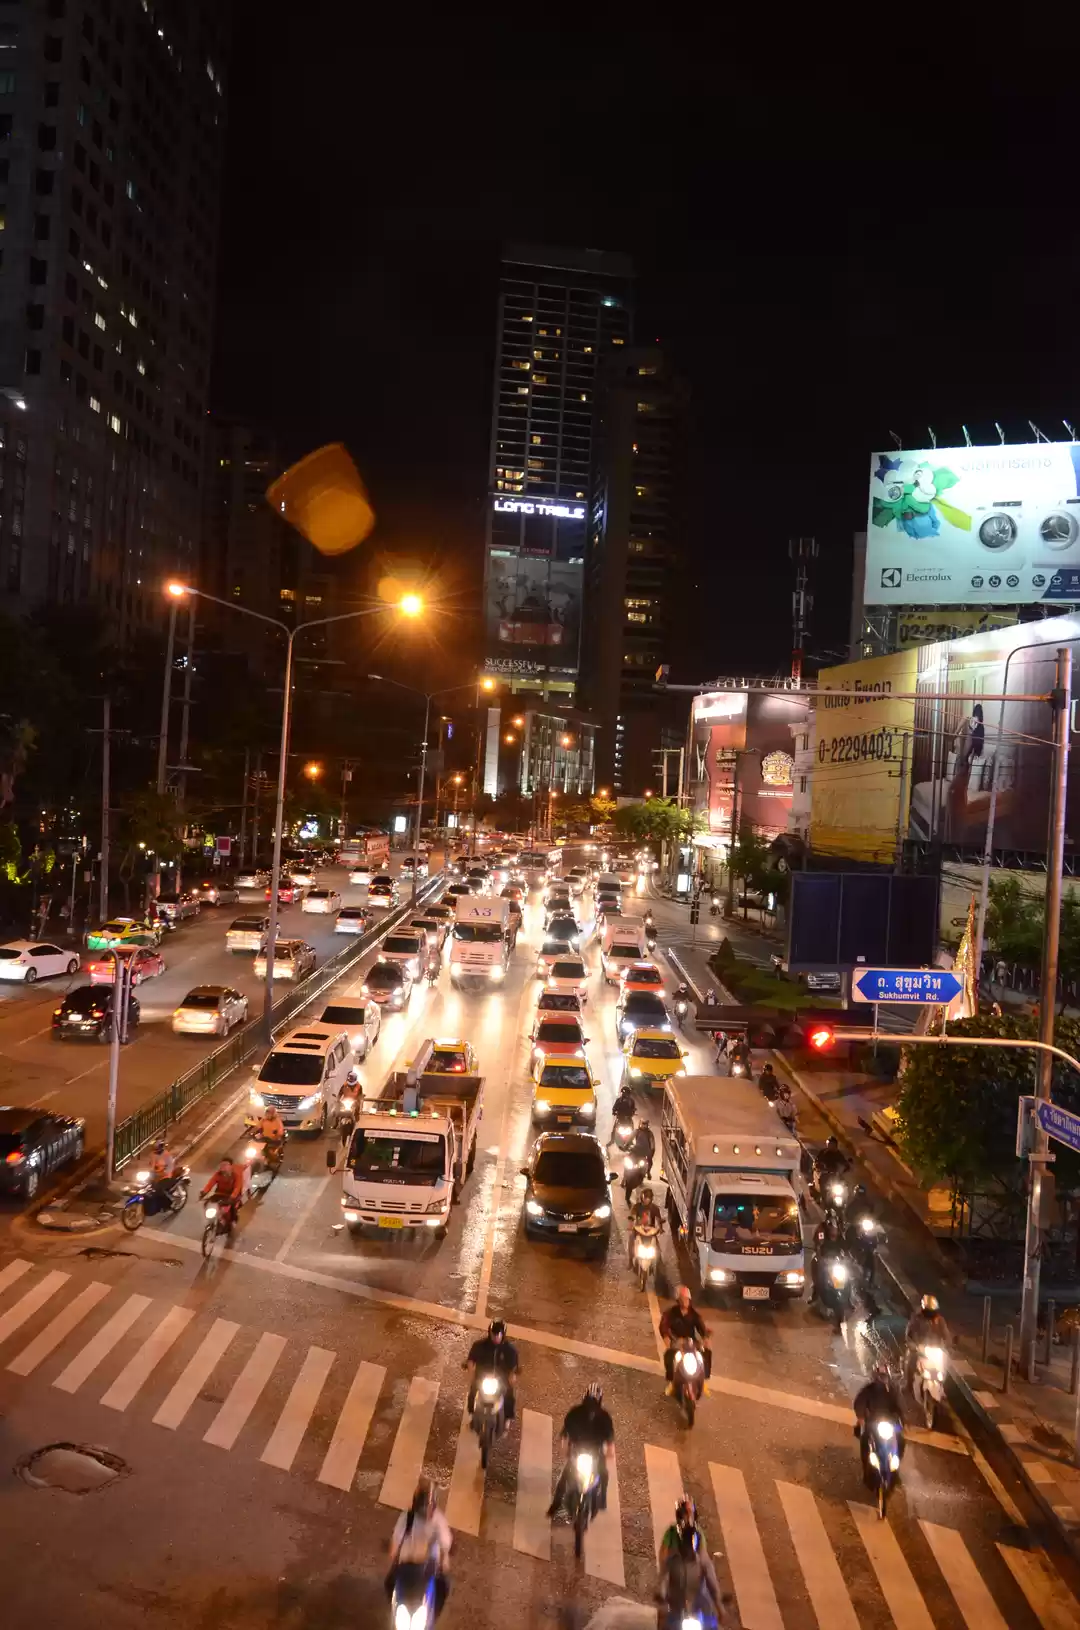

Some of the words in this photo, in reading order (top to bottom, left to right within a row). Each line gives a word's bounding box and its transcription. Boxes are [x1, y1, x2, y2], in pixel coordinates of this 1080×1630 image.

[494, 500, 535, 514] LONG
[536, 504, 585, 519] TABLE
[906, 573, 952, 582] Electrolux
[484, 657, 537, 670] SUCCESSFUL
[877, 977, 889, 988] ถ.
[895, 974, 942, 992] สุขุมวิท
[878, 991, 920, 1000] Sukhumvit
[925, 993, 939, 1001] Rd.
[741, 1246, 774, 1255] ISUZU
